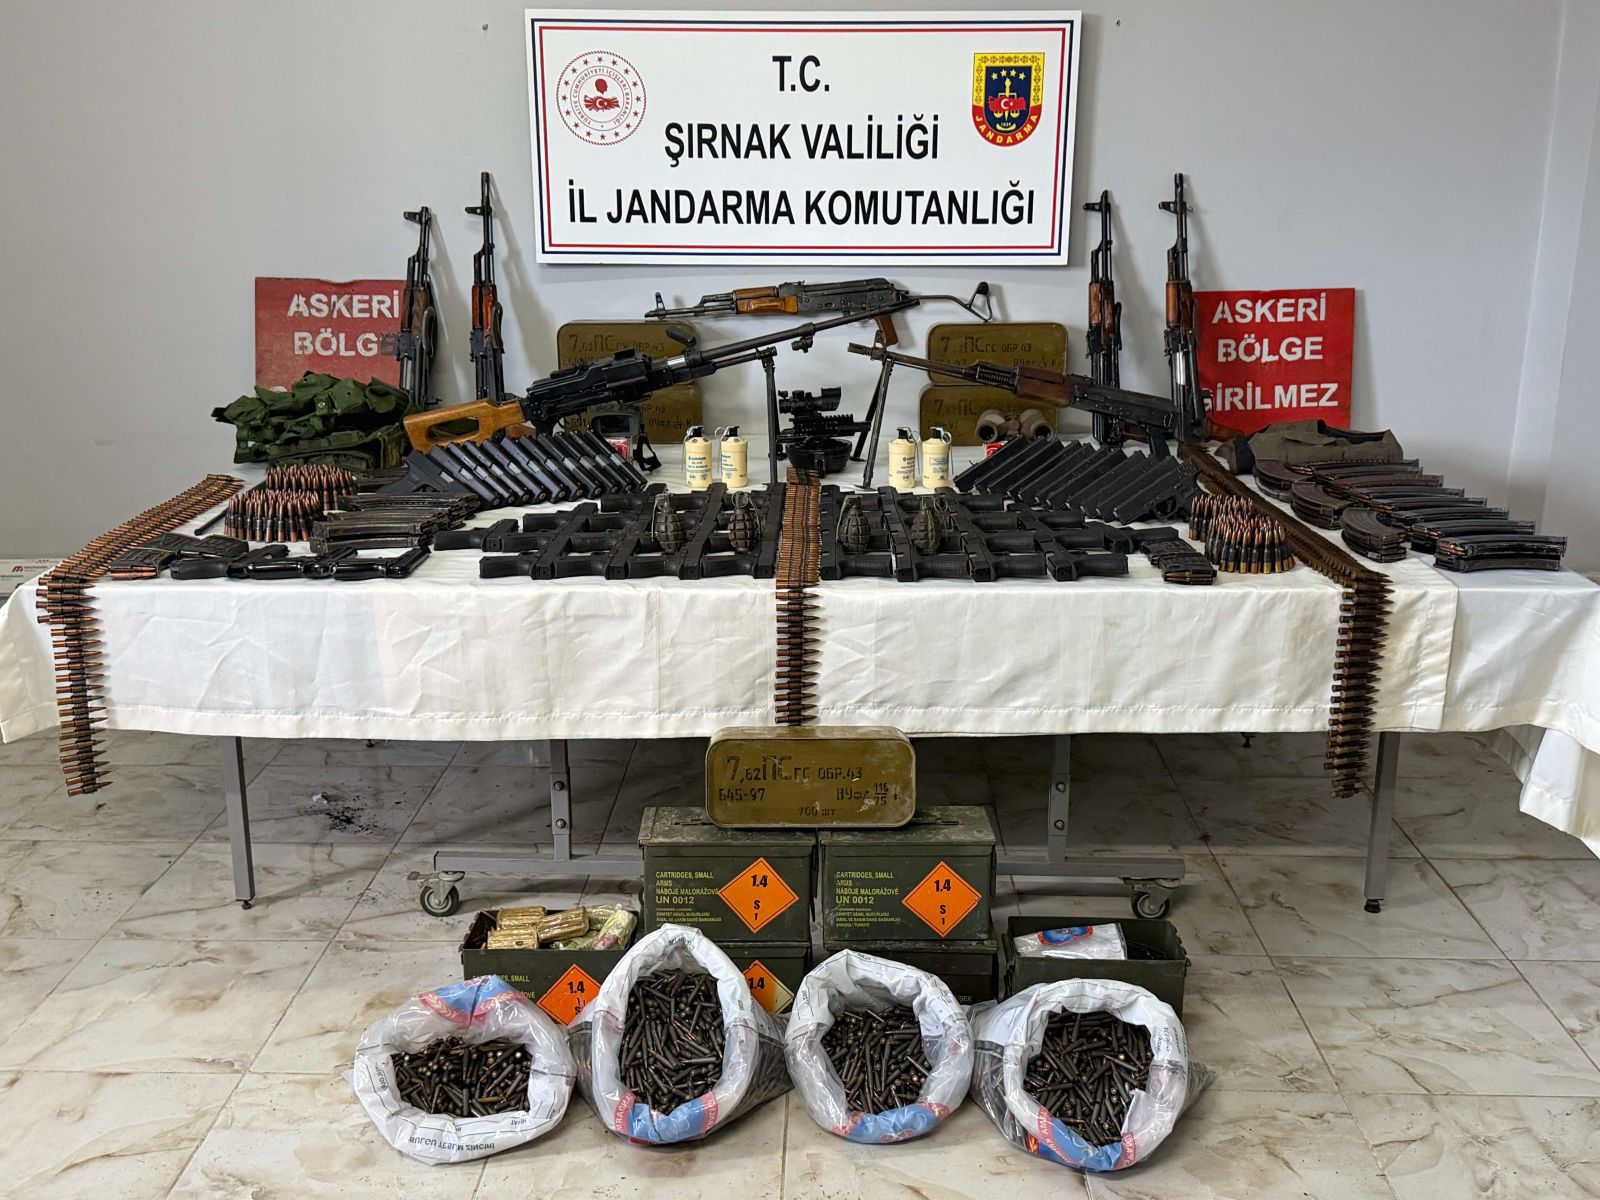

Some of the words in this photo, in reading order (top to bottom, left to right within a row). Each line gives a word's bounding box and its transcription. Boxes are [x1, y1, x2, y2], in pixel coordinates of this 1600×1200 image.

[773, 55, 830, 93] T.C.
[975, 114, 1038, 144] JANDARMA
[664, 122, 792, 167] ŞIRNAK
[802, 113, 939, 159] VALİLİĞİ
[569, 179, 596, 224] İL
[607, 189, 795, 225] JANDARMA
[805, 179, 1035, 225] KOMUTANLIĞI
[287, 290, 399, 318] ASKERİ
[1212, 293, 1326, 324] ASKERİ
[294, 328, 378, 357] BÖLG
[1217, 333, 1324, 363] BÖLGE
[818, 767, 863, 780] ОБР.43
[874, 782, 888, 792] 116
[656, 871, 694, 879] CARTRIDGES,
[695, 871, 714, 879] SMALL
[751, 875, 768, 888] 1.4
[836, 871, 874, 879] CARTRIDGES,
[875, 871, 894, 879] SMALL
[934, 879, 951, 892] 1.4
[656, 896, 669, 904] UN
[672, 896, 695, 904] 0012
[754, 900, 760, 910] S
[836, 896, 849, 904] UN
[852, 896, 875, 904] 0012
[940, 905, 946, 914] S
[754, 913, 758, 921] 1
[567, 981, 585, 994] 1.4
[747, 977, 765, 990] 1.4
